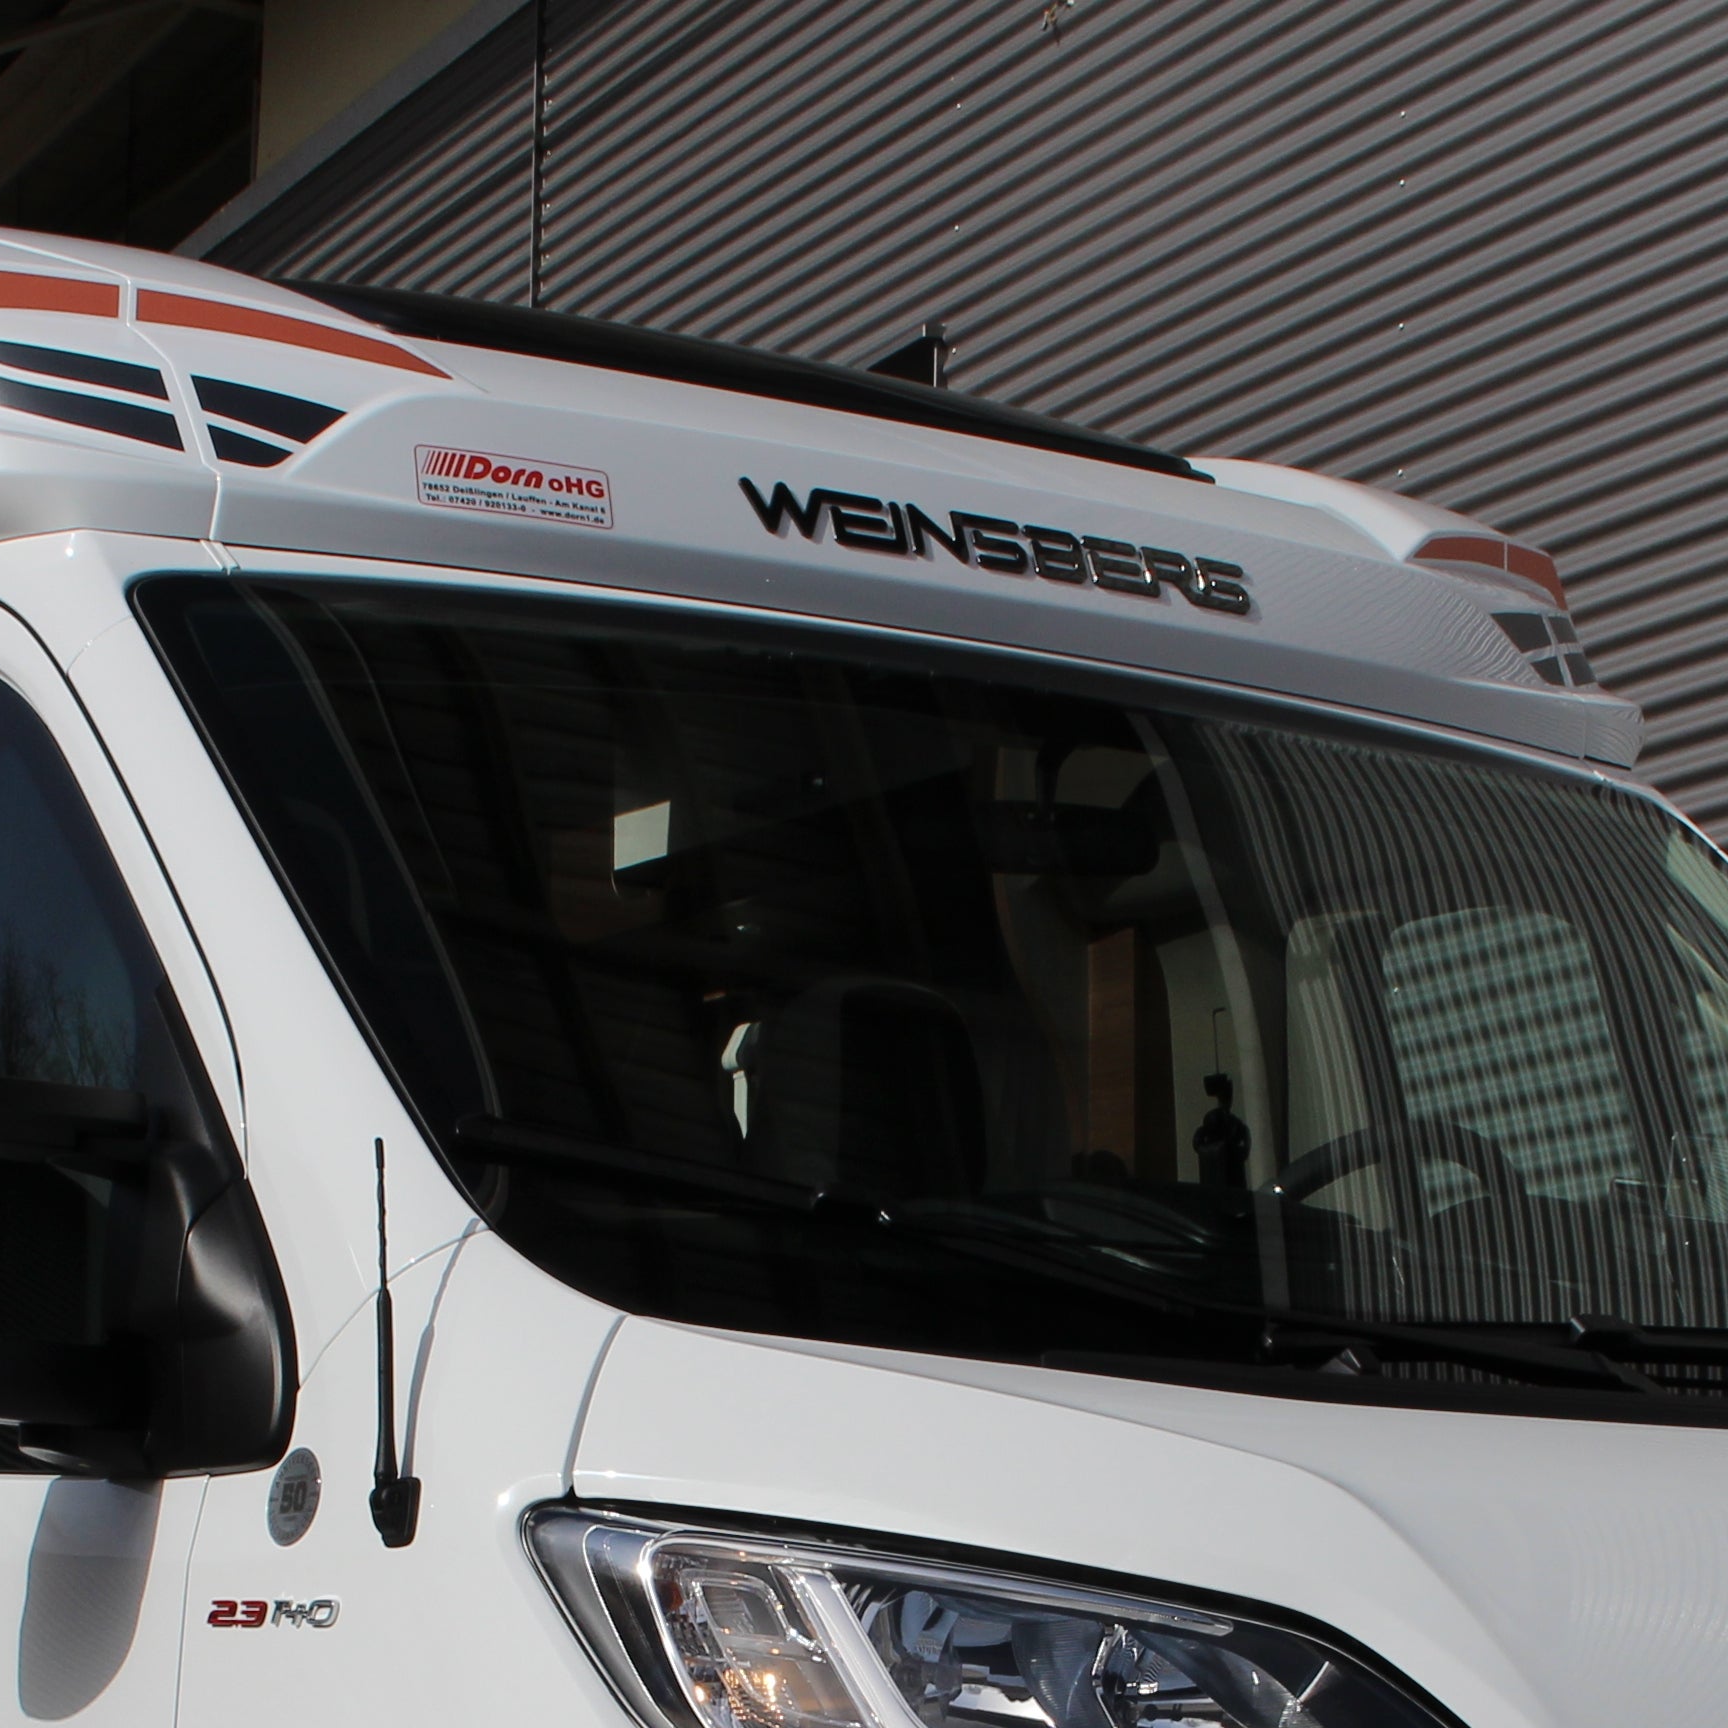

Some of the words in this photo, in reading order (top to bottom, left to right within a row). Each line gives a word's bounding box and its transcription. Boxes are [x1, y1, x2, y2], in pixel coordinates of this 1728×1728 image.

[422, 482, 450, 493] 78652
[462, 454, 544, 489] Dorn
[548, 475, 605, 499] oHG
[738, 475, 1252, 615] WEINSBERG
